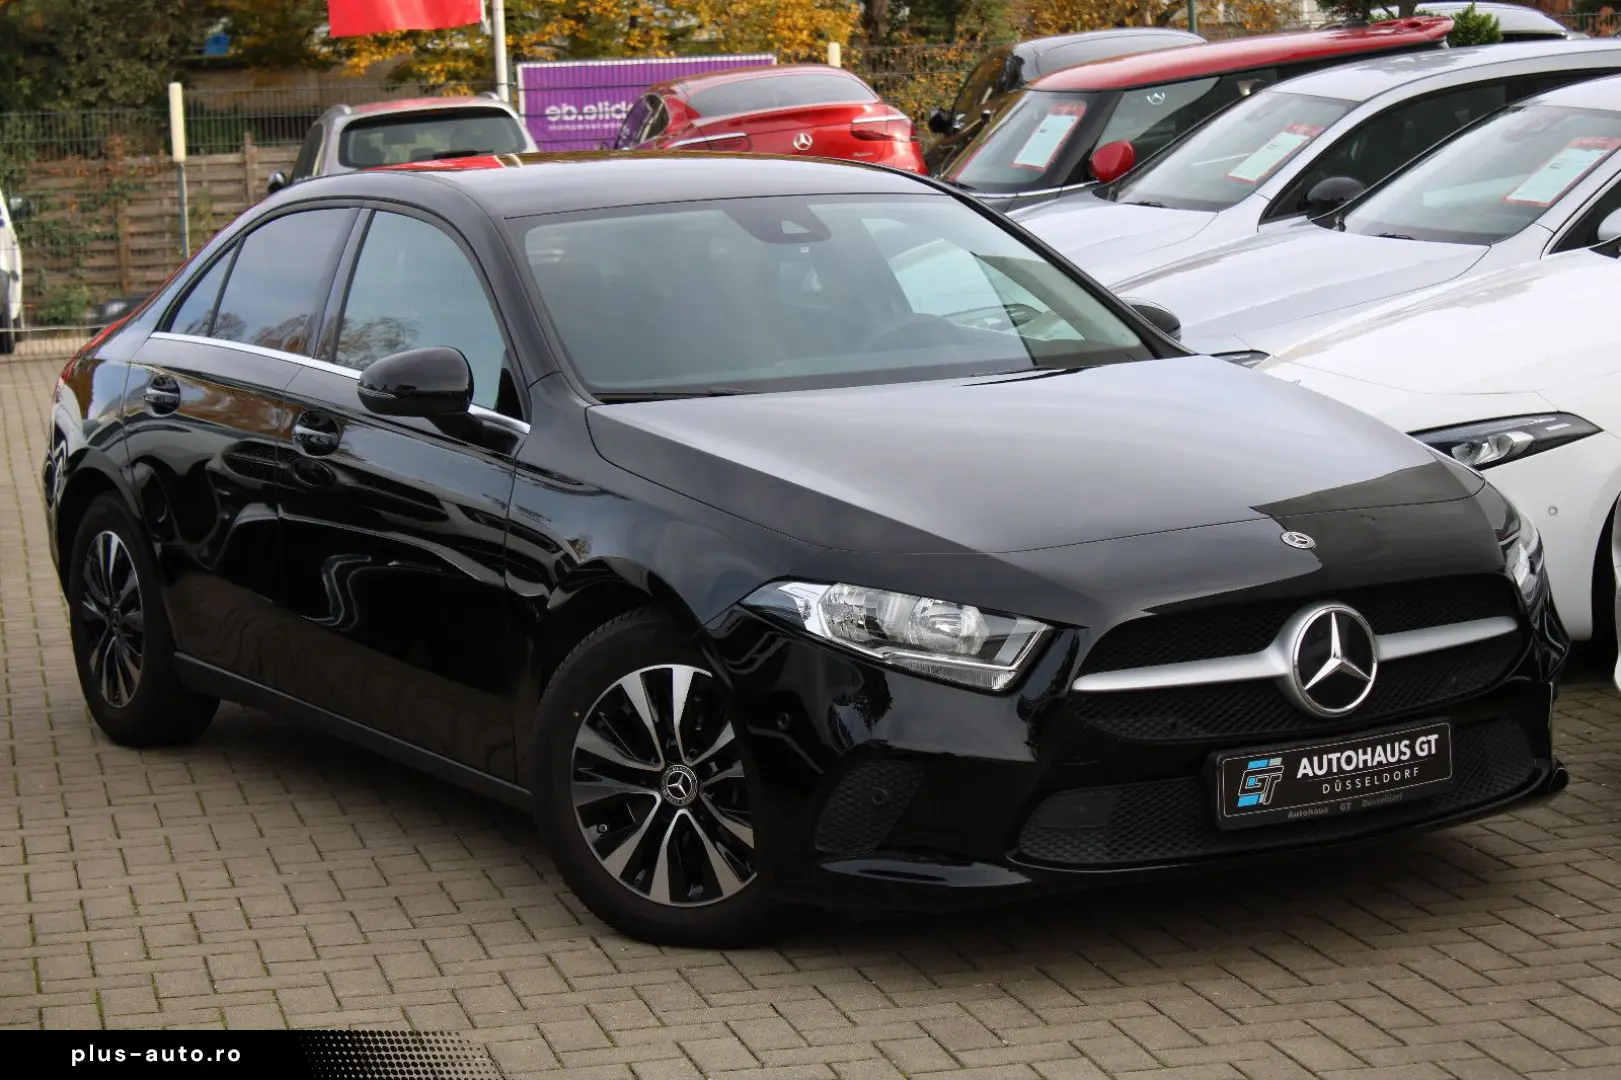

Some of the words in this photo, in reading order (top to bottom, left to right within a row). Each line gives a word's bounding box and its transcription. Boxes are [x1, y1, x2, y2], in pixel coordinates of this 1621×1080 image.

[1296, 740, 1411, 778] AUTOHAUS
[1414, 734, 1439, 757] GT
[1322, 766, 1421, 794] DÜSSELDORF
[1287, 806, 1329, 819] Autohaus
[1339, 801, 1352, 811] GT
[1361, 793, 1403, 807] Düsseldorf
